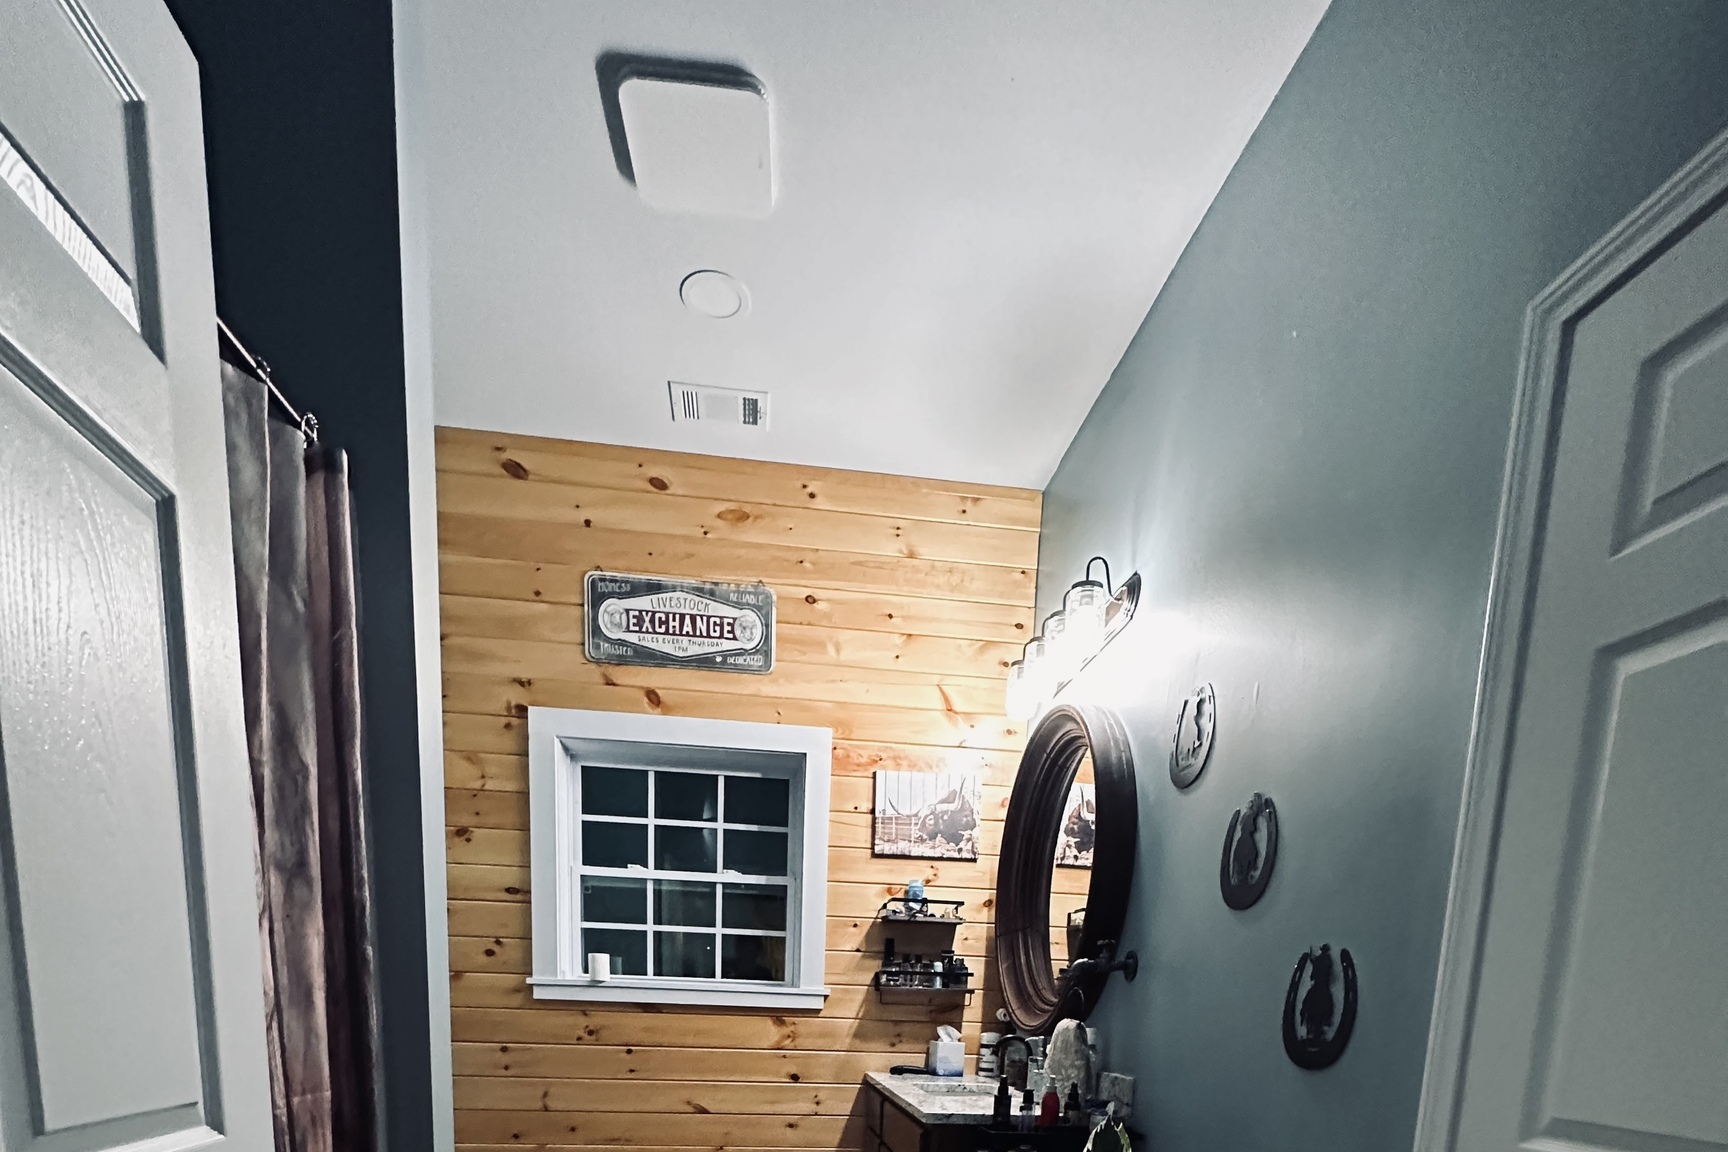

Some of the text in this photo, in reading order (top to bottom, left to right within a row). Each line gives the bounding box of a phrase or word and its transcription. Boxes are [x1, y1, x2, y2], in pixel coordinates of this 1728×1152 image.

[650, 597, 712, 614] LIVESTOCK
[729, 592, 765, 606] RELIABLE
[628, 610, 734, 639] EXCHANGE
[638, 635, 724, 648] SALES EVERY THURSDAY
[674, 645, 689, 653] 1PM
[727, 655, 763, 666] DEDICATED
